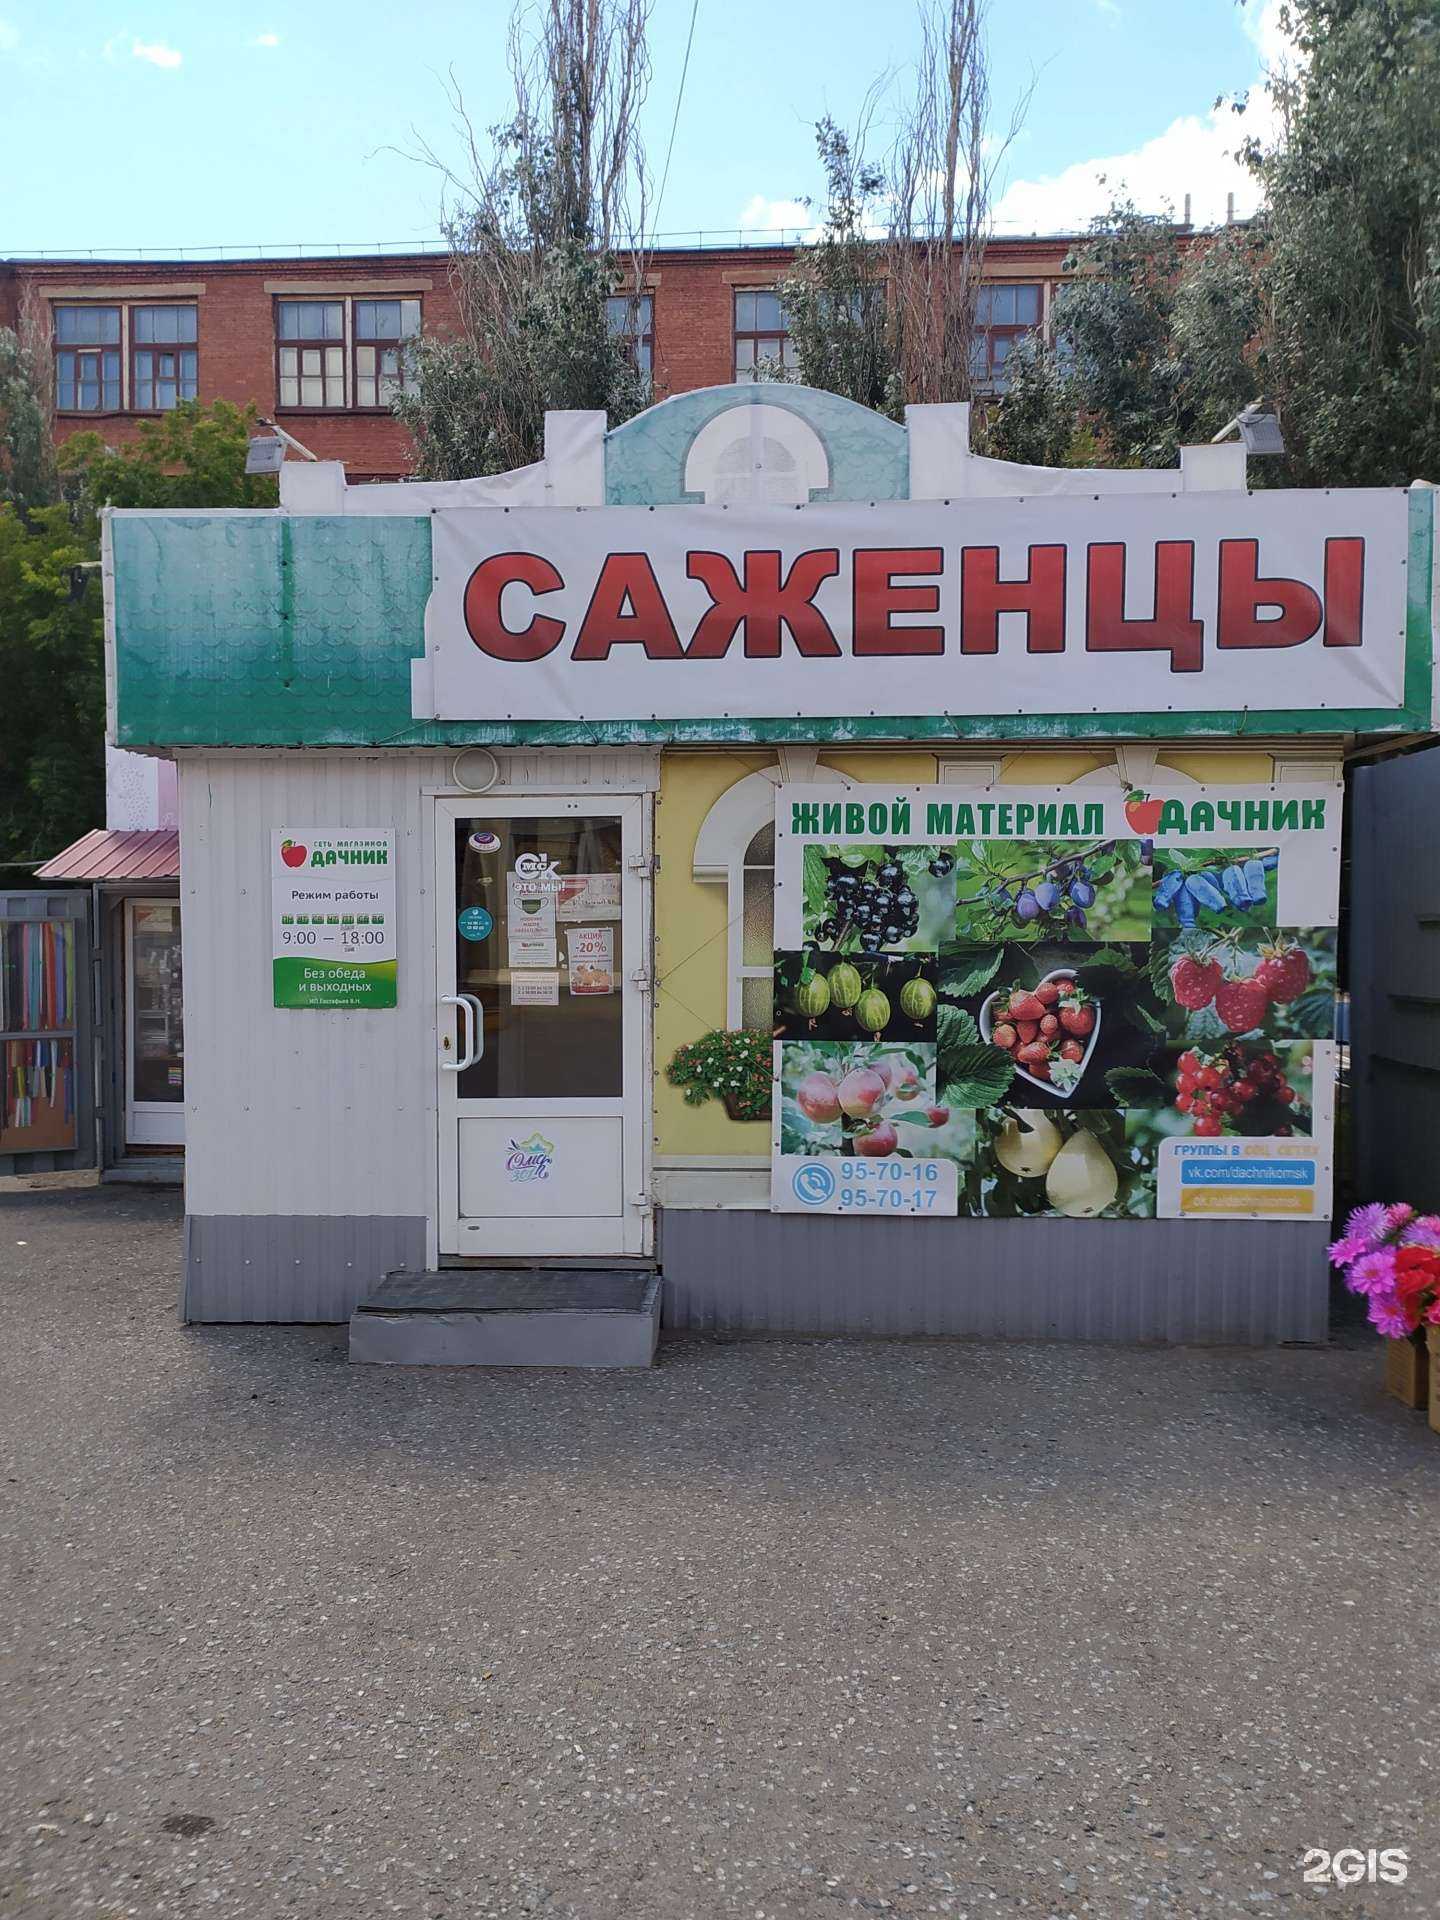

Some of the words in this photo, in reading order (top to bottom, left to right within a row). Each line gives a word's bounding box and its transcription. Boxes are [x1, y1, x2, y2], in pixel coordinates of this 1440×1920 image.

[463, 536, 1366, 674] САЖЕНЦЫ
[791, 796, 912, 835] ЖИВОЙ
[926, 803, 1105, 835] МАТЕРИАЛ
[1157, 798, 1327, 835] ДАЧНИК
[313, 840, 333, 848] СЕТЬ
[336, 840, 388, 848] МАГАЗИНОВ
[310, 849, 388, 868] ДАЧНИК
[291, 890, 332, 900] Режим
[335, 890, 379, 902] работы
[281, 931, 317, 945] 9:00
[340, 931, 385, 945] 18:00
[575, 941, 608, 953] -20%
[304, 967, 326, 979] Без
[328, 967, 366, 980] обеда
[298, 983, 306, 992] и
[309, 983, 373, 993] выходных
[1173, 1144, 1228, 1156] ГРУППЫ
[840, 1161, 938, 1181] 95-70-16
[840, 1188, 938, 1208] 95-70-17
